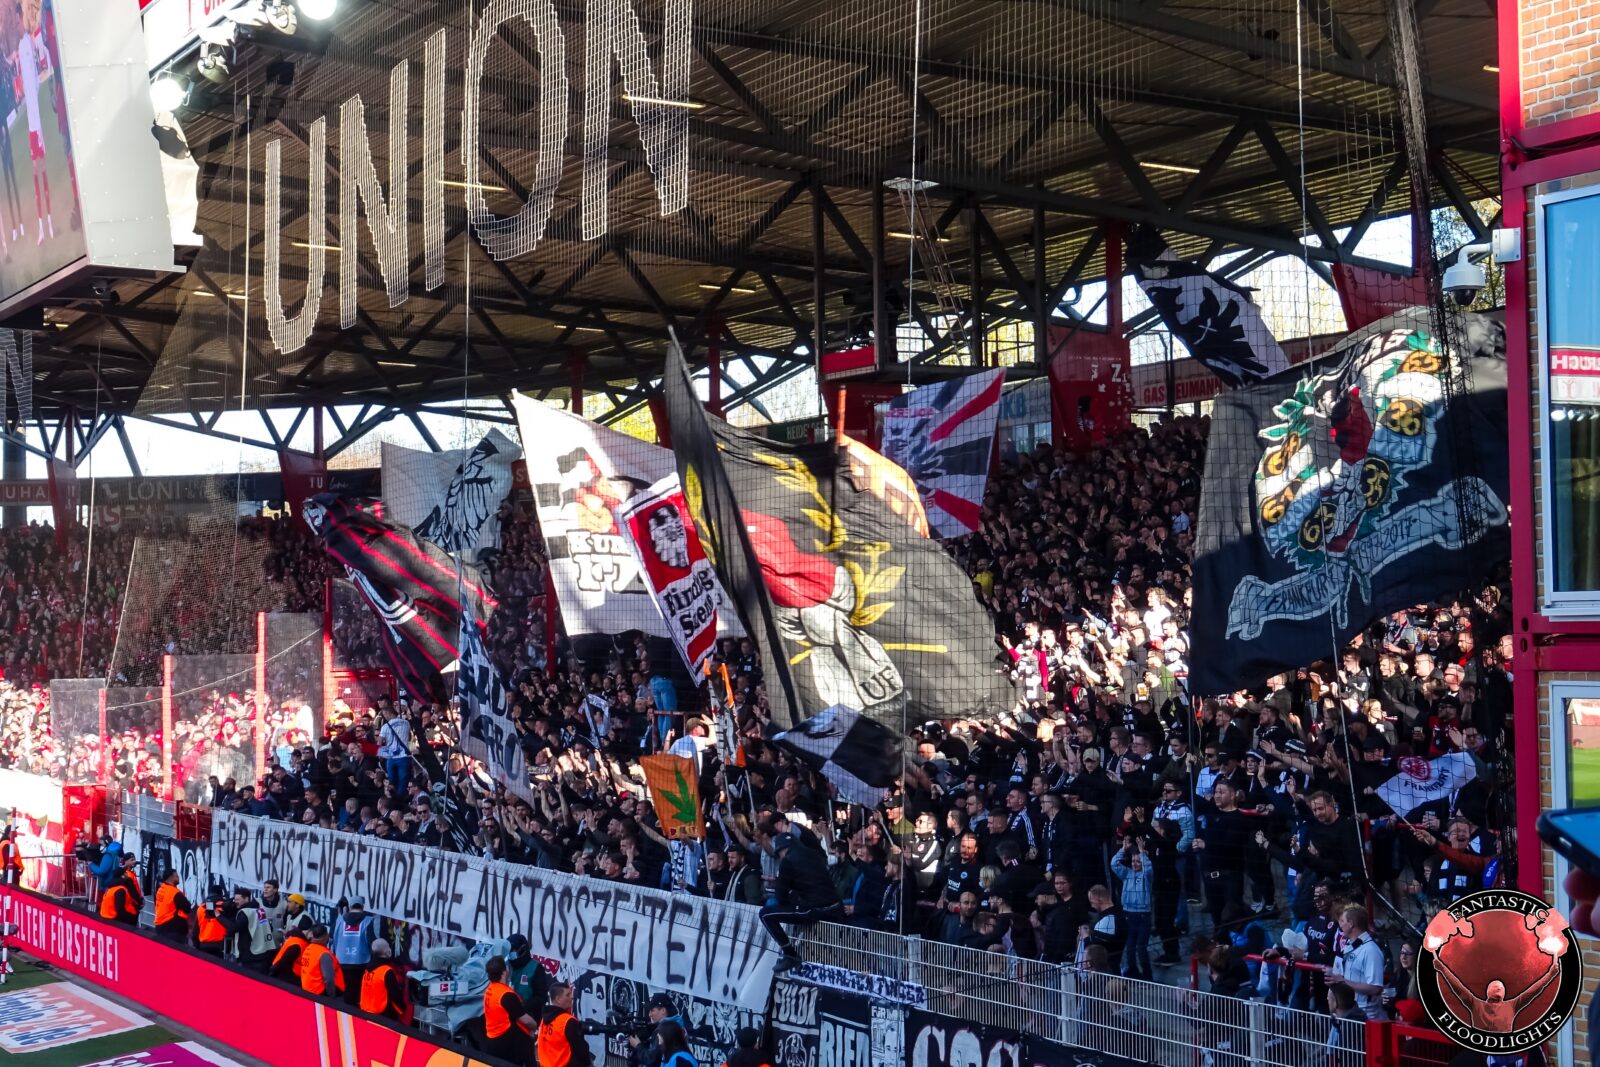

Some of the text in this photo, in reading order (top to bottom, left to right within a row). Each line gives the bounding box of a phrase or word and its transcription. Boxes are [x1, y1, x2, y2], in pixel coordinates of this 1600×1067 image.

[264, 0, 693, 354] UNION
[128, 479, 181, 501] LONI
[1404, 767, 1450, 793] FRANKFURT
[218, 813, 249, 872] FÜR
[253, 825, 468, 933] CHRISTENFREUNDLICHE
[13, 899, 47, 951] ALTEN
[50, 909, 119, 982] FÖRSTEREI
[771, 980, 819, 1026] FULDA
